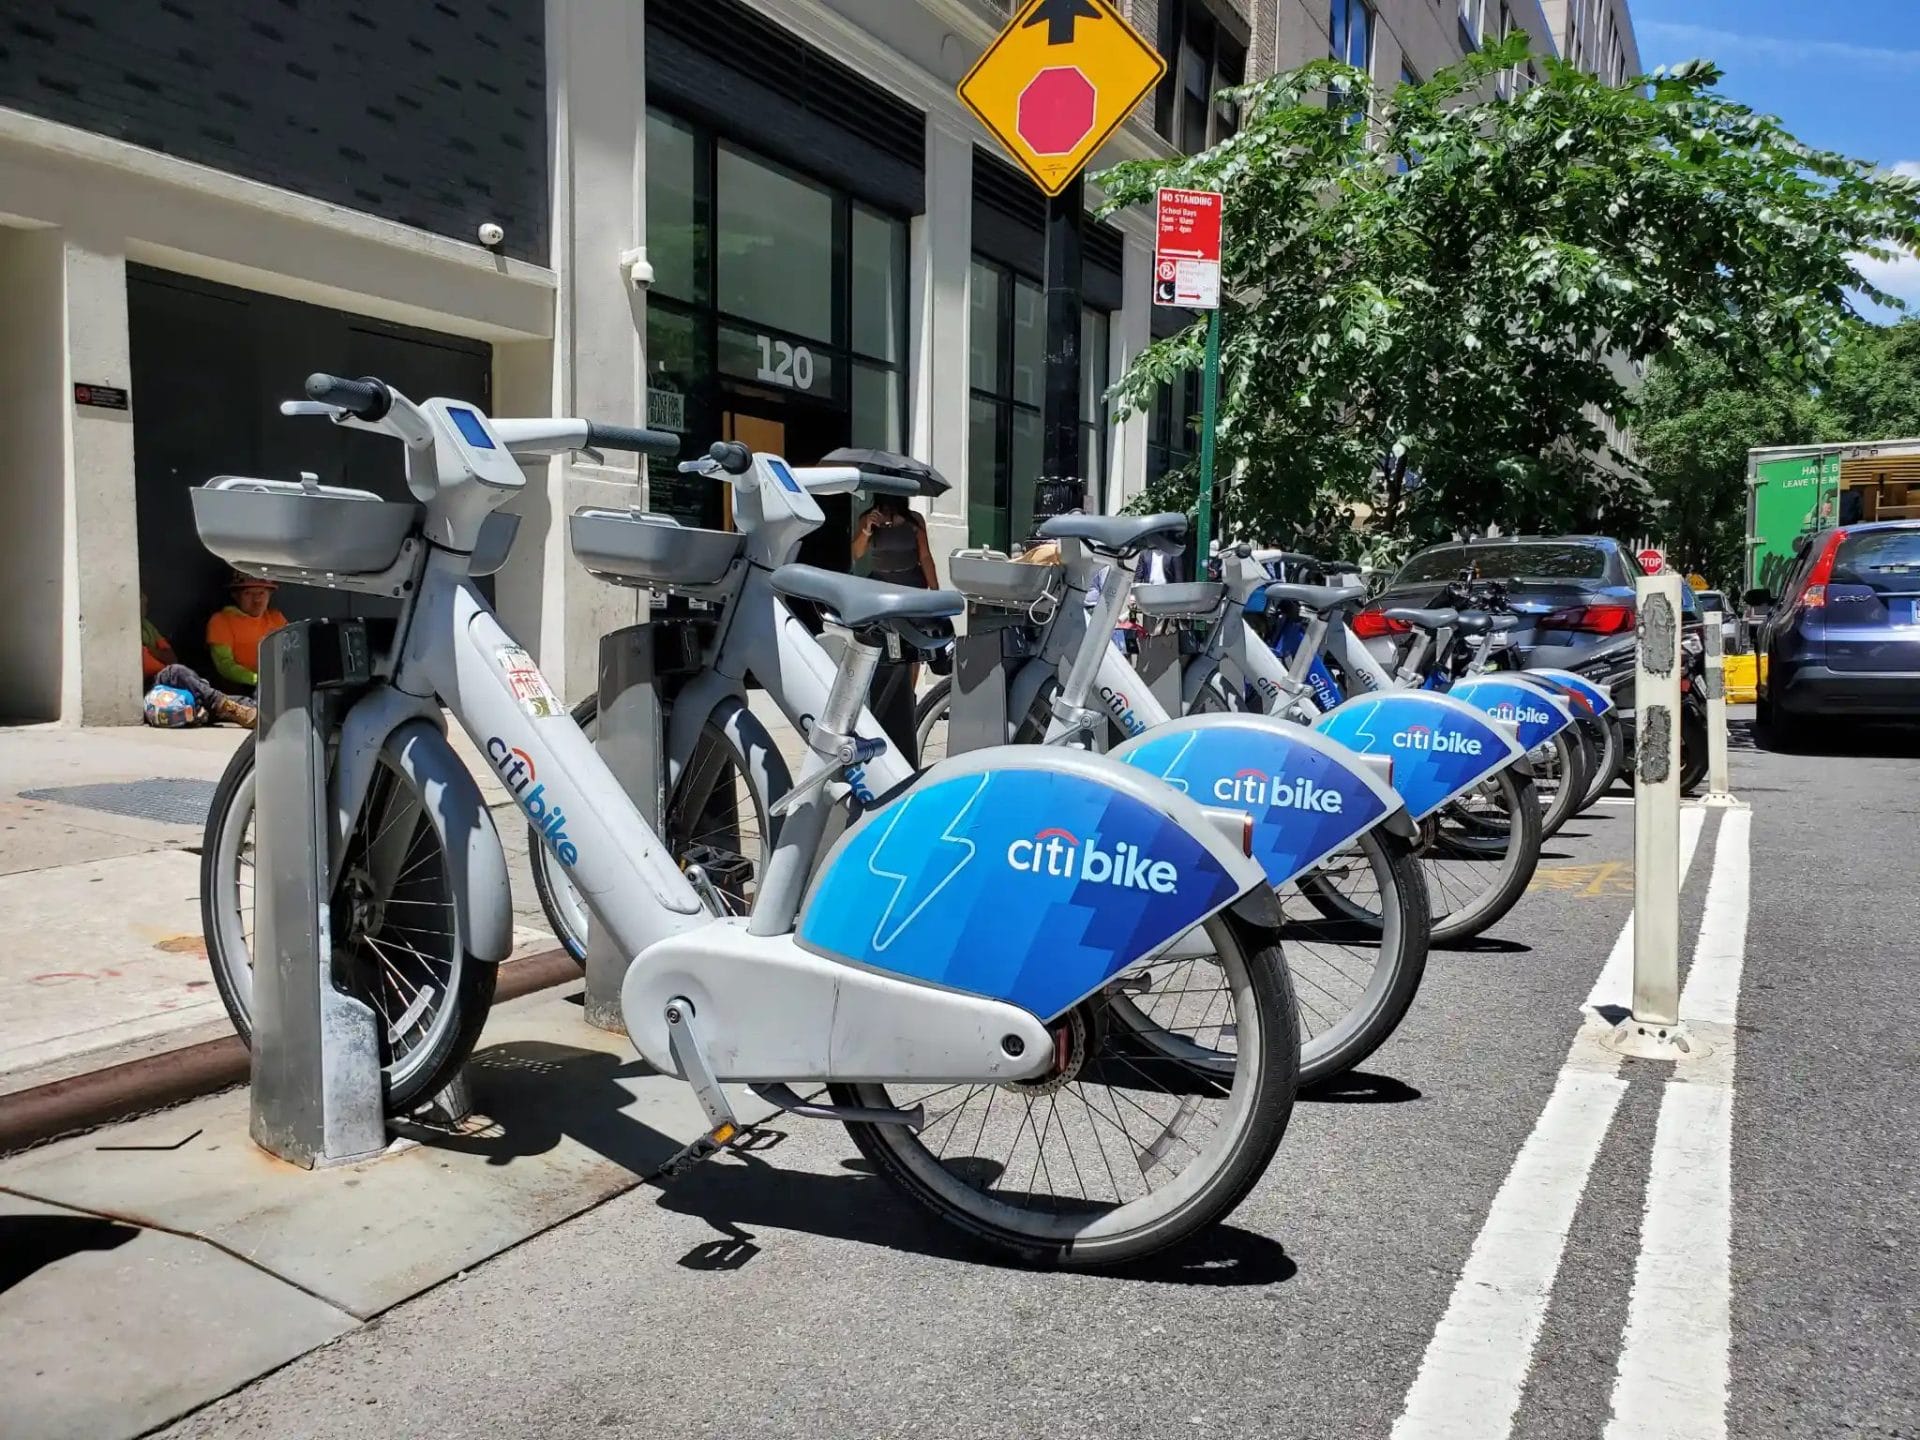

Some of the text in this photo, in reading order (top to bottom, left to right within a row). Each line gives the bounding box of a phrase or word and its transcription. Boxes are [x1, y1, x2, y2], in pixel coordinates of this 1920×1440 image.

[1161, 191, 1212, 206] NO STANDING
[1161, 206, 1197, 217] School Days
[757, 334, 813, 389] 120
[1783, 478, 1808, 488] LEAVE
[1638, 557, 1662, 568] STOP
[1257, 677, 1279, 698] citi
[1320, 690, 1336, 710] bik
[1101, 687, 1146, 736] citi bi
[1487, 703, 1549, 724] citi bike
[1393, 726, 1482, 756] citi bike
[487, 736, 534, 793] citi
[524, 784, 578, 866] bike
[1214, 769, 1343, 814] citi bike
[1008, 829, 1178, 894] citi bike
